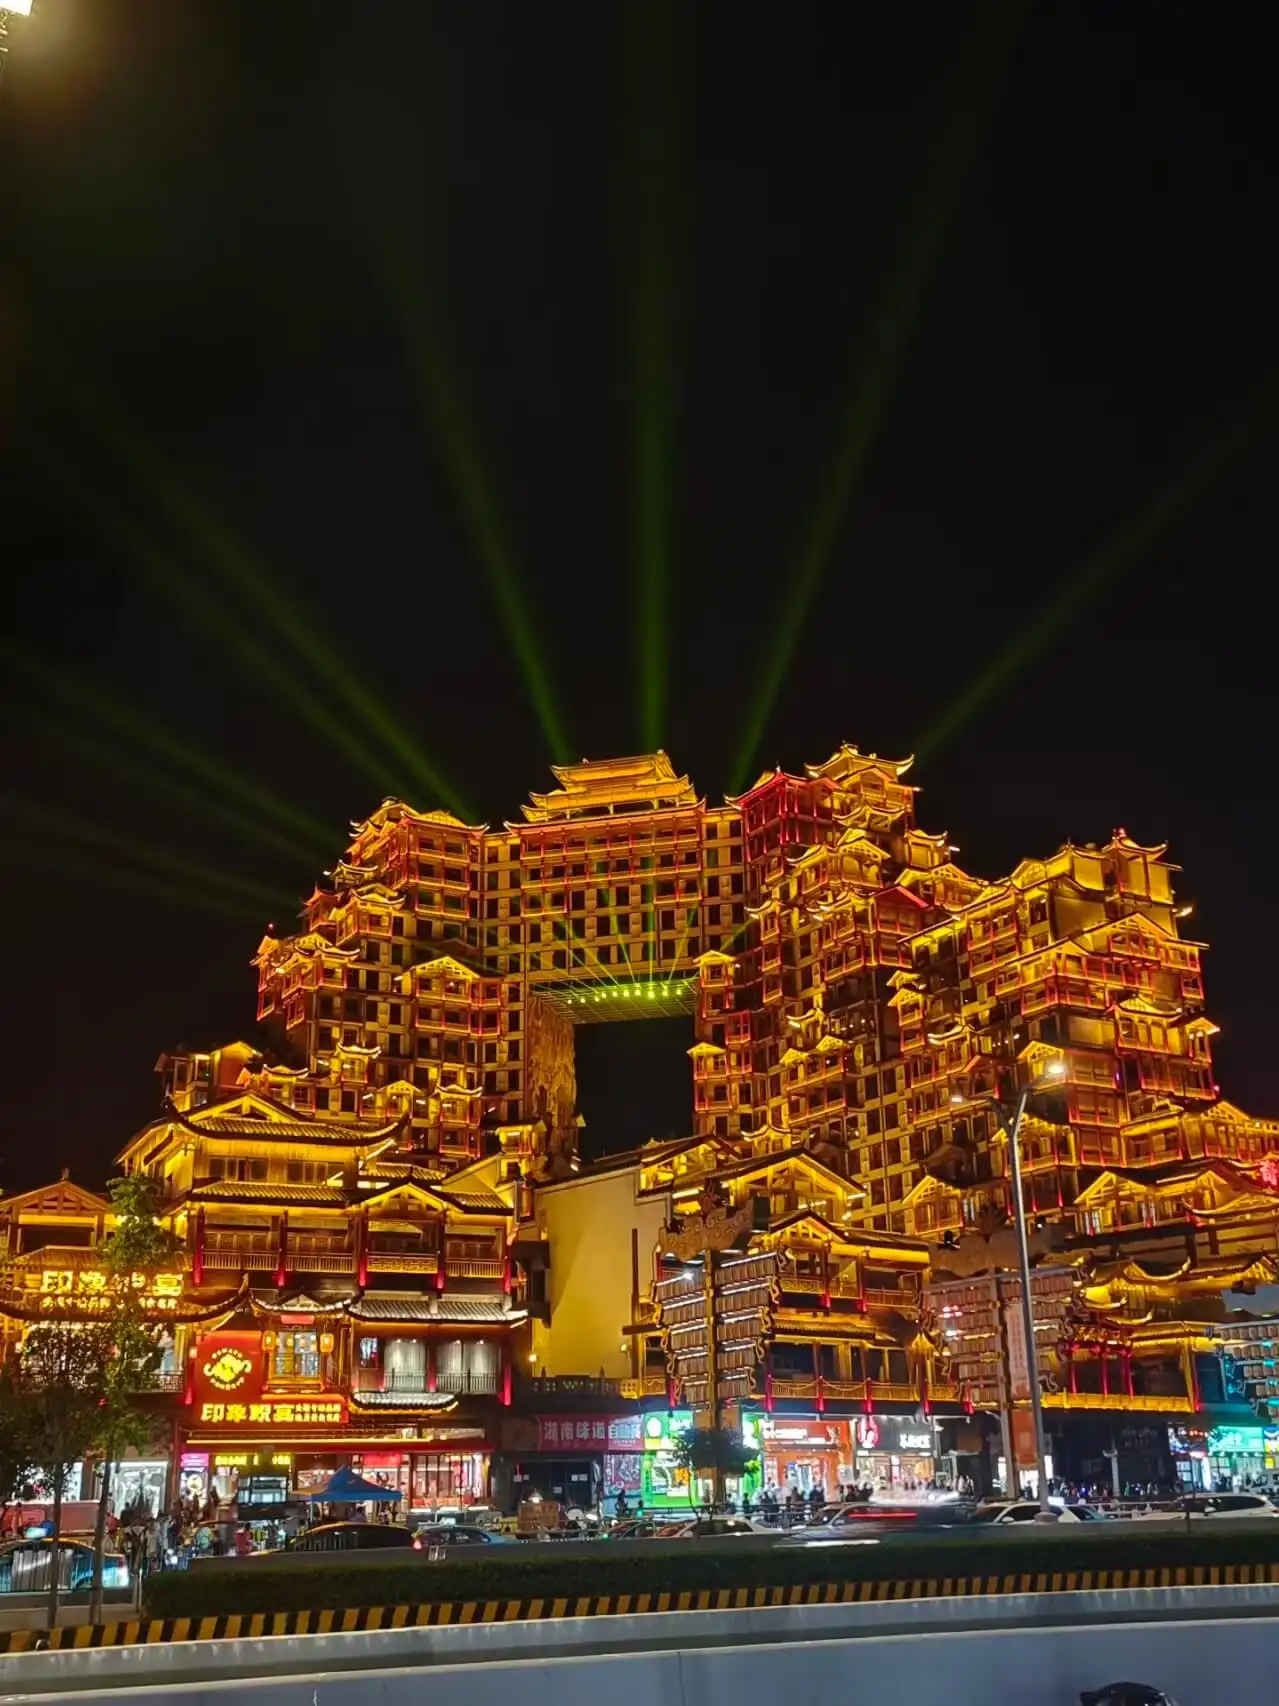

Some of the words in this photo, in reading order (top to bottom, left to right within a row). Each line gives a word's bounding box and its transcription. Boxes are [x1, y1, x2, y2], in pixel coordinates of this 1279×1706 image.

[39, 1270, 184, 1297] 印象宴
[543, 1420, 606, 1440] 湖南味道
